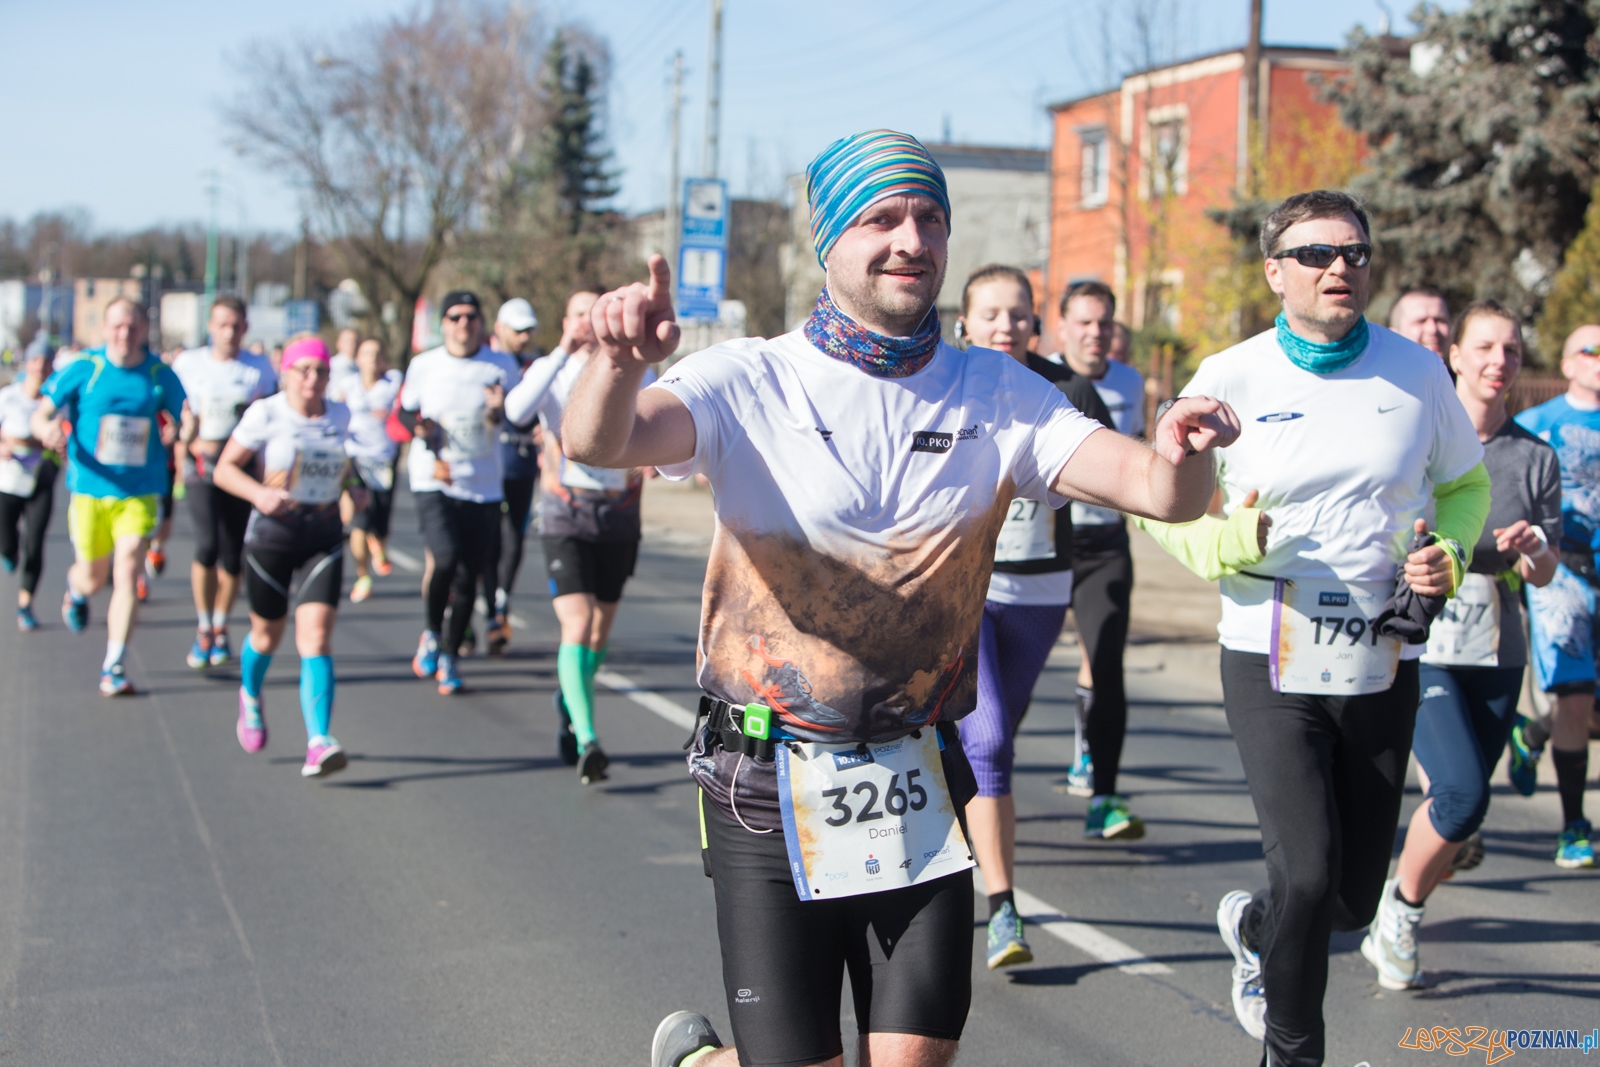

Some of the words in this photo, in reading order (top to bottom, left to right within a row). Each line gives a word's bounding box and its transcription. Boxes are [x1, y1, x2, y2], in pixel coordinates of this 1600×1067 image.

[929, 437, 951, 448] PKO
[1331, 595, 1348, 603] PKO
[1310, 616, 1378, 647] 1791
[1335, 652, 1353, 660] Jan
[836, 755, 851, 766] 10.
[821, 768, 928, 827] 3265
[868, 821, 908, 840] Daniel
